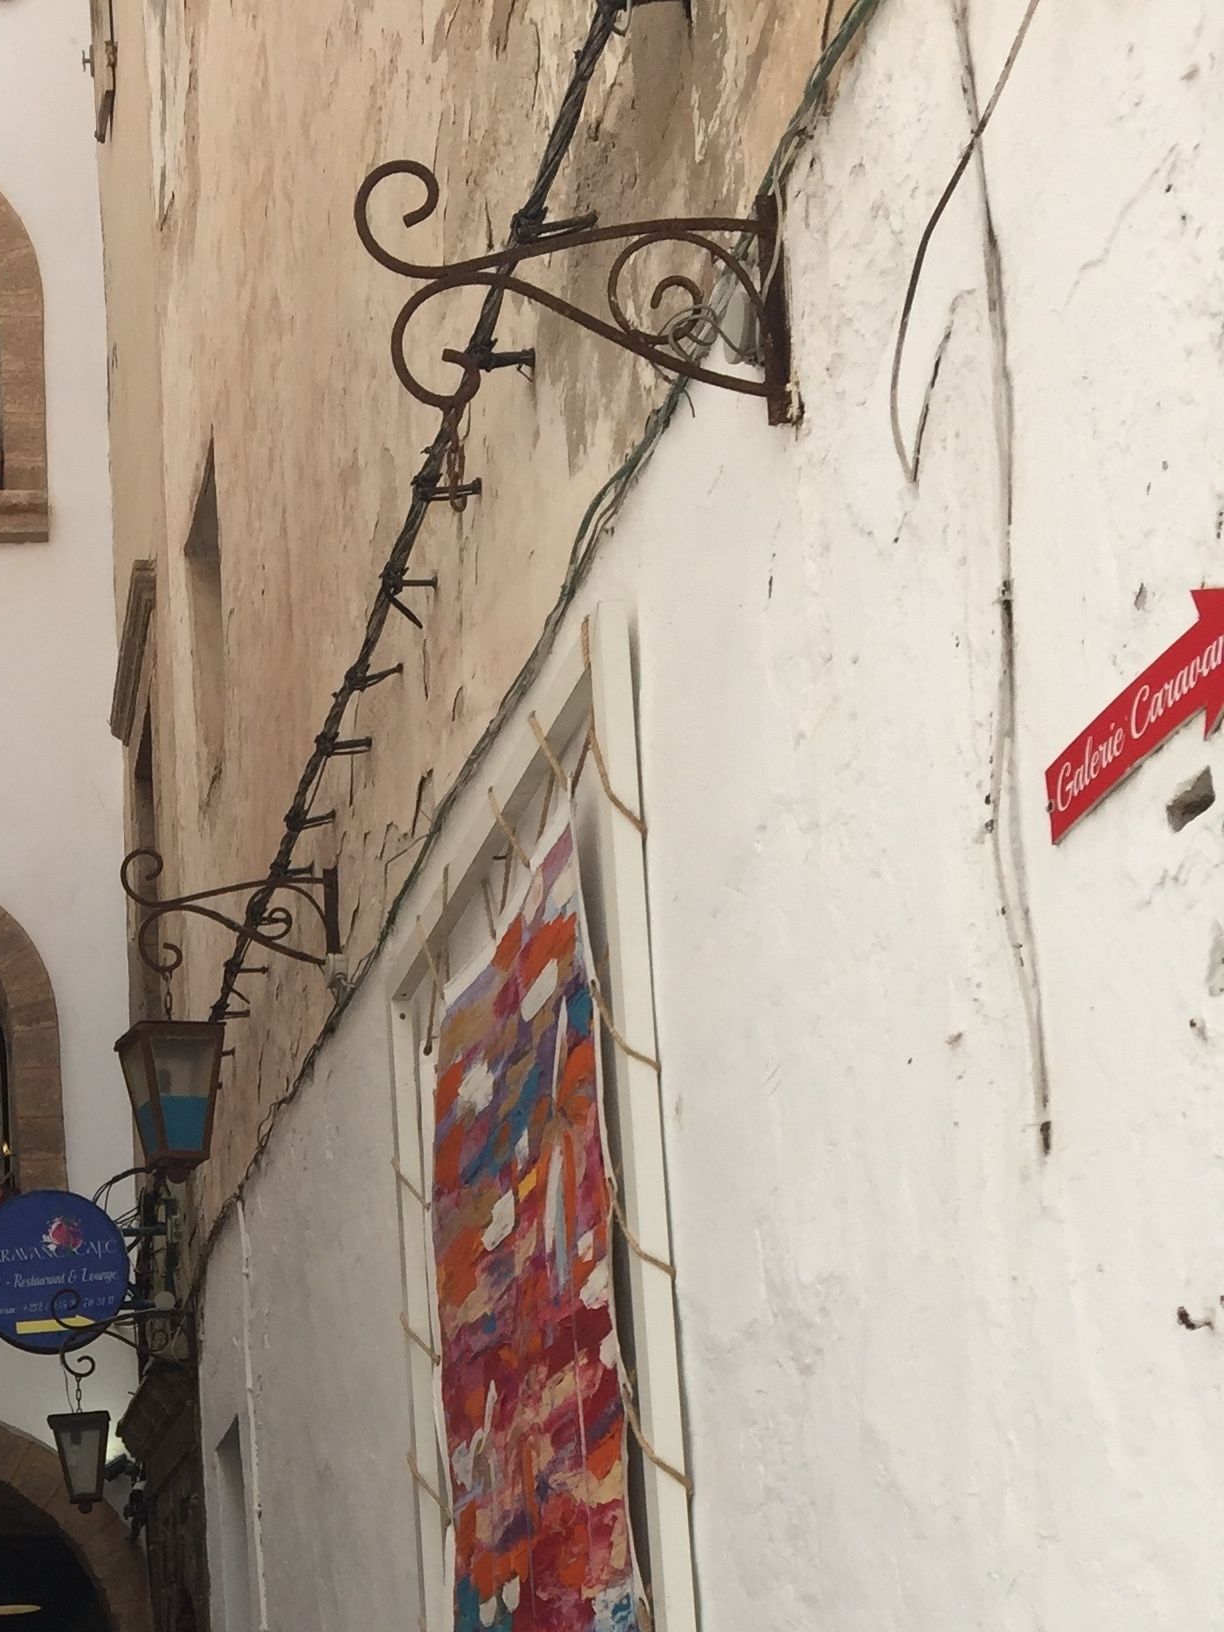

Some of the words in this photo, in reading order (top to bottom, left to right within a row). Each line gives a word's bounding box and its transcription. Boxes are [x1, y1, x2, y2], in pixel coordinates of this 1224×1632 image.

[1056, 721, 1124, 813] Galerie
[14, 1271, 66, 1288] Restaurant
[68, 1269, 77, 1284] &
[81, 1267, 119, 1285] Lounge
